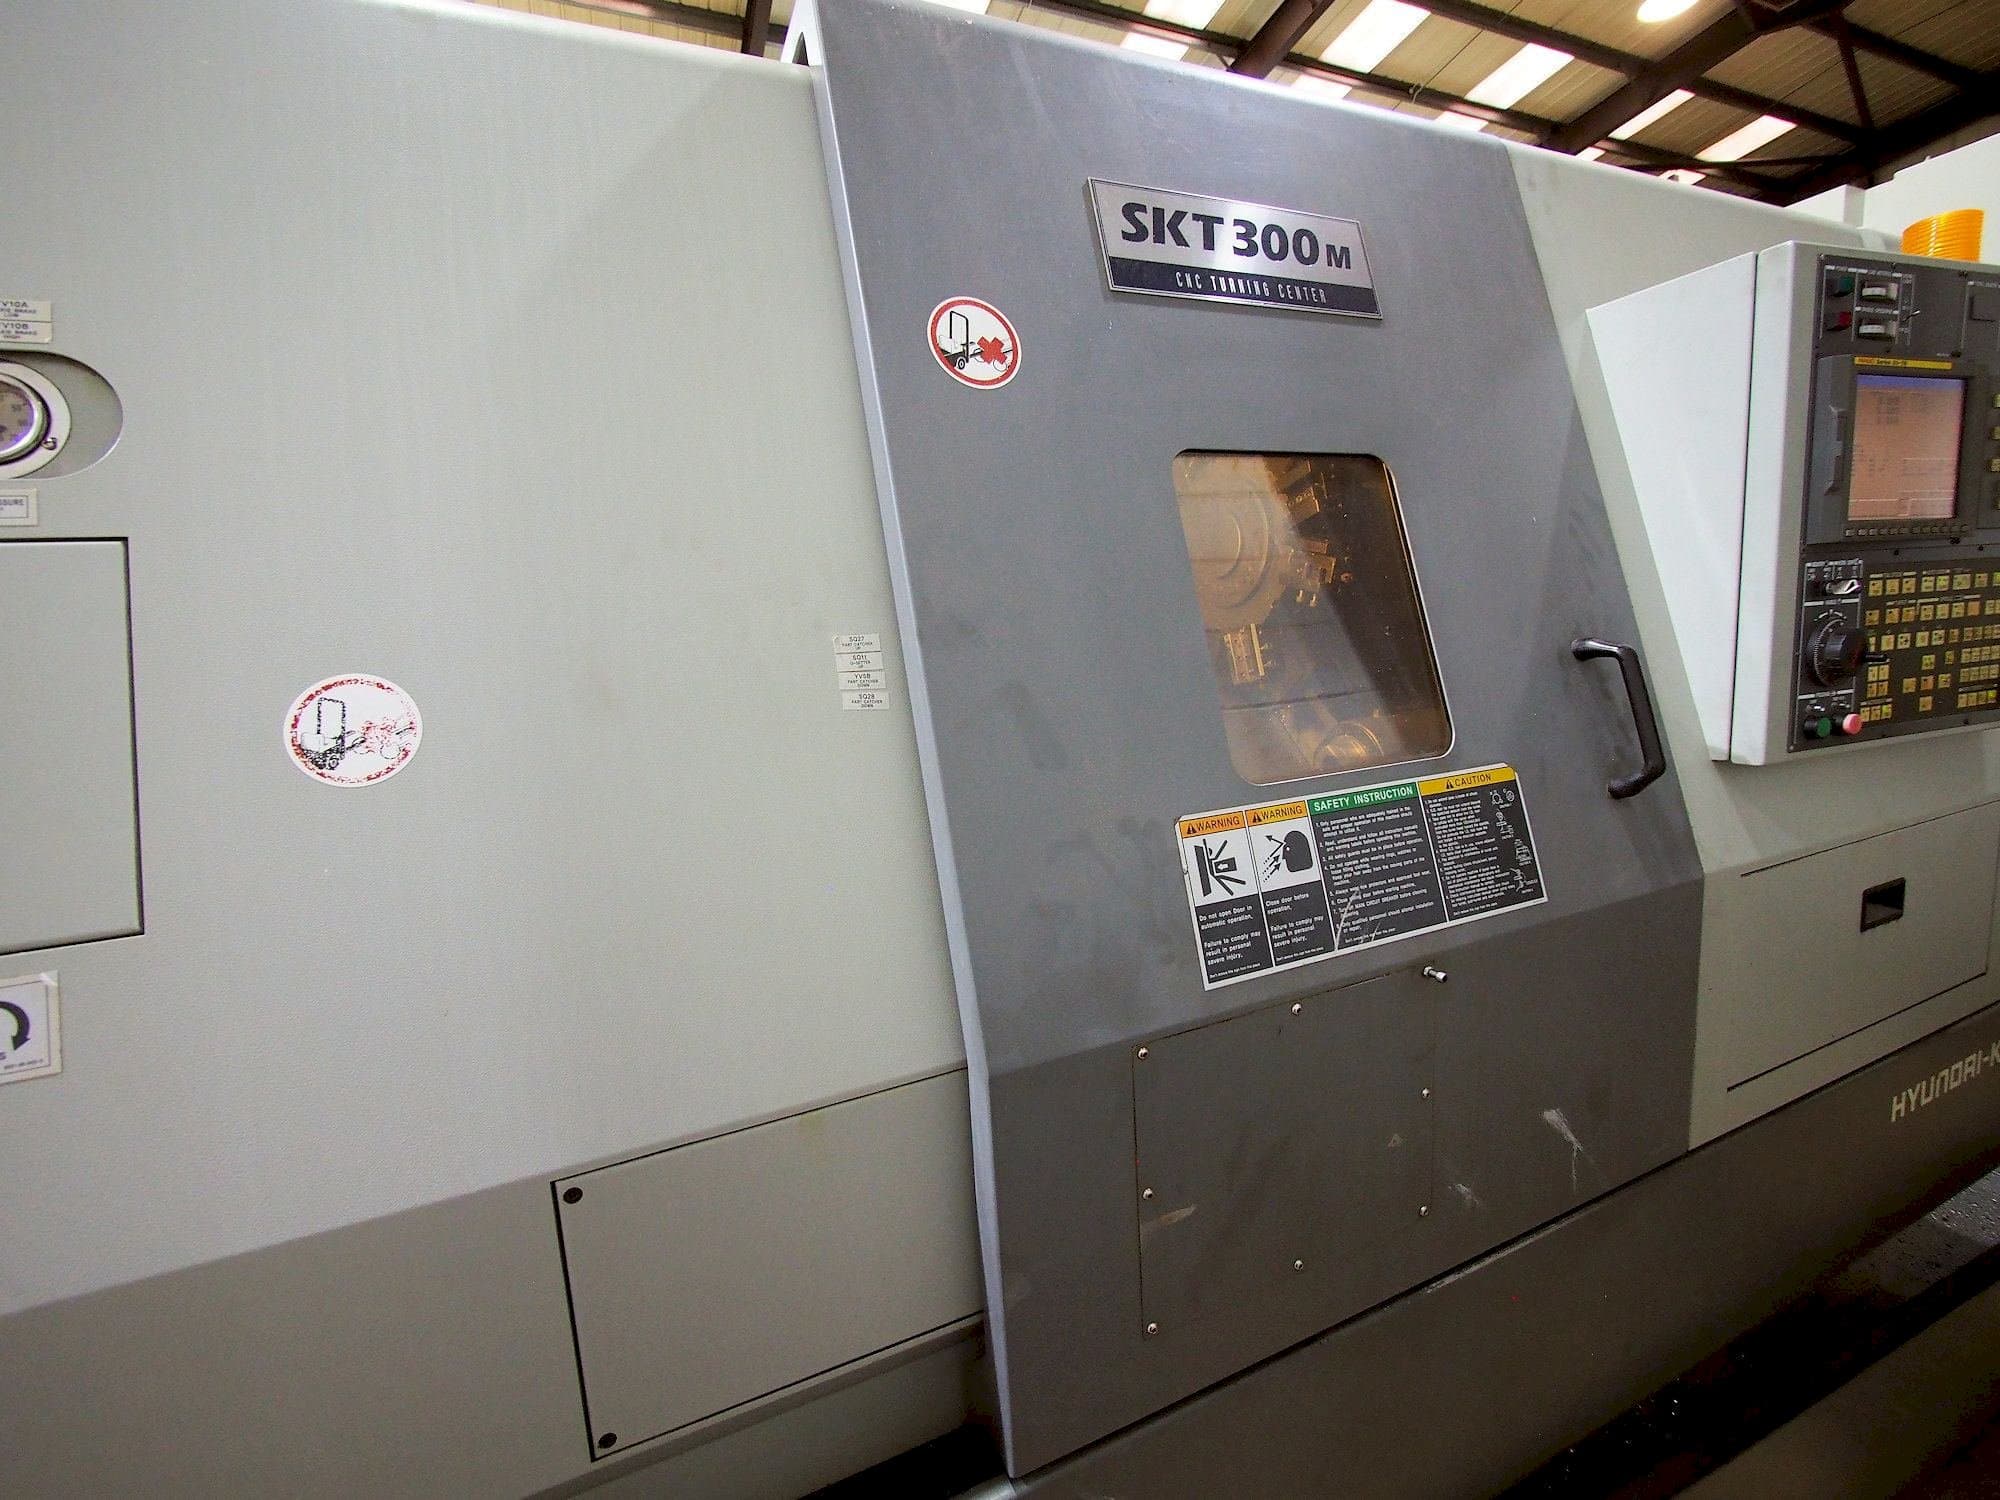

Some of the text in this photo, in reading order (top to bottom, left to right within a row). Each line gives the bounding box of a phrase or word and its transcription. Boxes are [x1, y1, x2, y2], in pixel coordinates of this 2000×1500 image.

[1176, 271, 1327, 304] CNC TURNING CENTER
[1455, 773, 1491, 787] CAUTION
[1314, 796, 1350, 812] SAFETY
[1354, 786, 1413, 805] INSTRUCTION
[1261, 805, 1303, 820] WARNING
[1196, 816, 1240, 831] WARNING
[1294, 893, 1309, 901] before
[1218, 910, 1232, 918] open
[1201, 920, 1226, 930] automatic
[1270, 924, 1288, 932] Failure
[1295, 917, 1313, 926] comply
[1204, 940, 1222, 948] Failure
[1231, 933, 1249, 942] comply
[1229, 941, 1251, 951] personal
[1273, 939, 1290, 947] severe
[1208, 957, 1225, 965] severe
